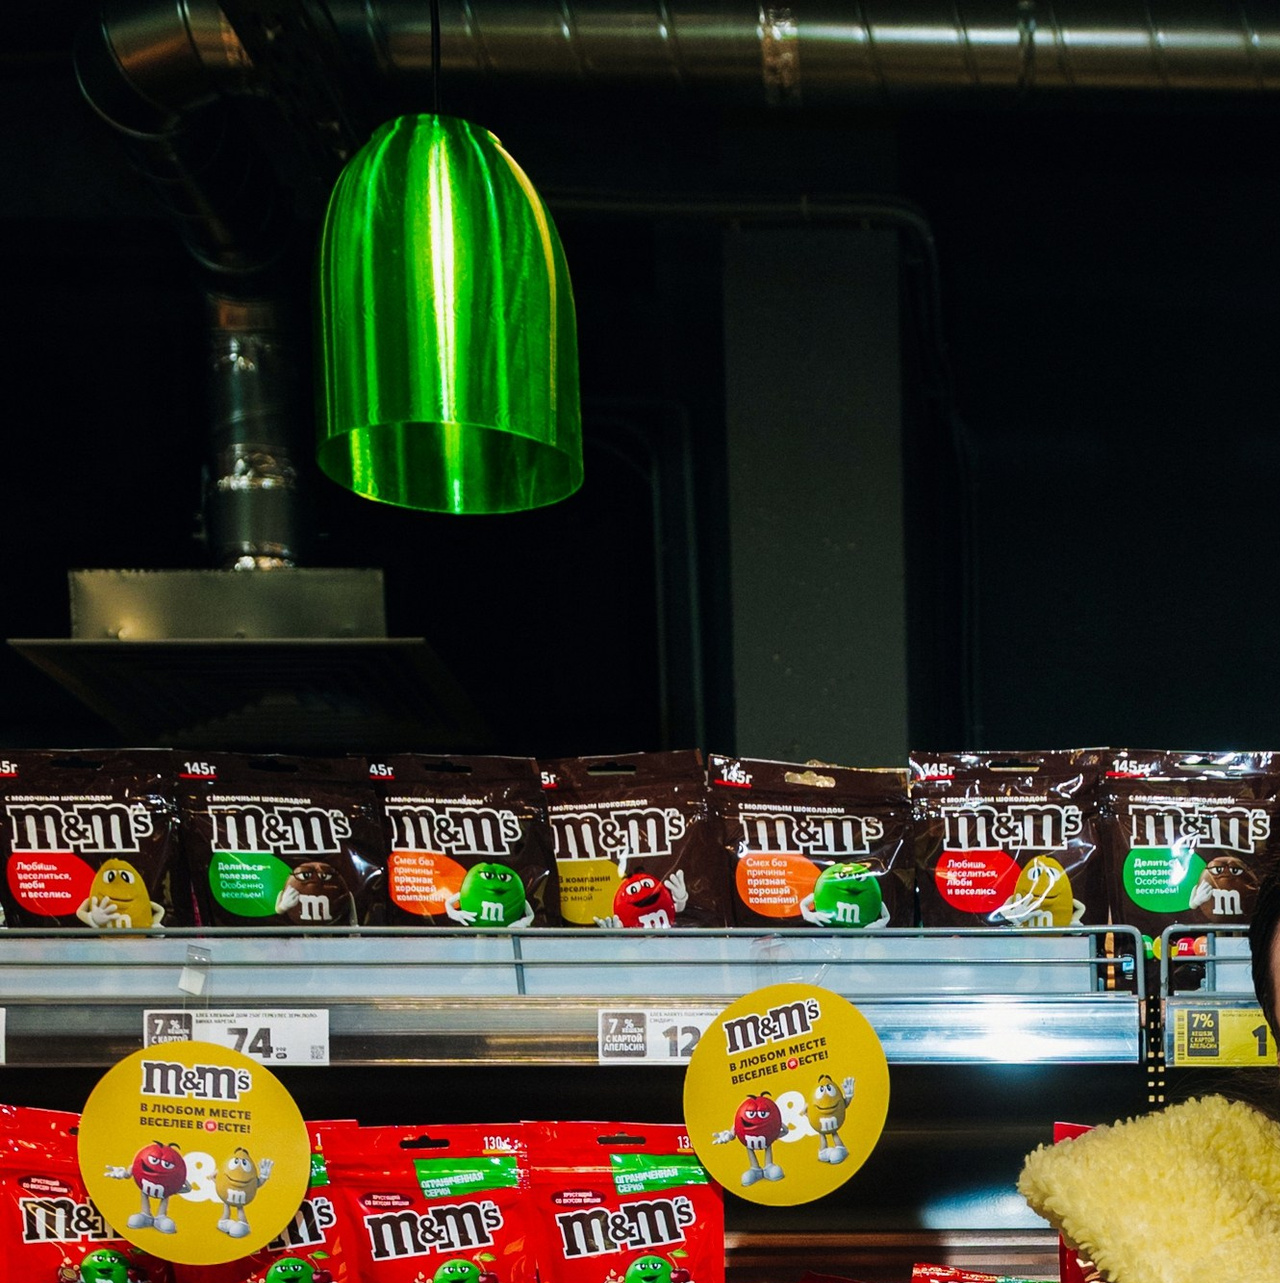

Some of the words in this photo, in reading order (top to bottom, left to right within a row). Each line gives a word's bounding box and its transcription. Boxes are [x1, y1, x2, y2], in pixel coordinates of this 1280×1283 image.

[184, 762, 216, 775] 145г
[922, 763, 955, 776] 145г
[609, 1019, 618, 1033] 7
[724, 999, 820, 1054] m&m's
[1192, 1014, 1214, 1027] 7%
[227, 1028, 273, 1058] 74
[612, 1034, 642, 1043] КАРТОЙ
[604, 1043, 645, 1052] АПЕЛЬСИН
[739, 1049, 785, 1069] ЛЮБОМ
[789, 1037, 827, 1055] МЕСТЕ
[142, 1061, 250, 1101] m&m's
[732, 1066, 778, 1085] ВЕСЕЛЕЕ
[152, 1104, 205, 1116] ЛЮБОМ
[210, 1109, 251, 1119] МЕСТЕ
[140, 1117, 193, 1129] ВЕСЕЛЕЕ
[421, 1172, 484, 1189] ОГРАНИЧЕННАЯ
[615, 1168, 678, 1184] ОГРАНИЧЕННАЯ
[365, 1202, 504, 1261] m&m's
[555, 1196, 696, 1259] m&m's
